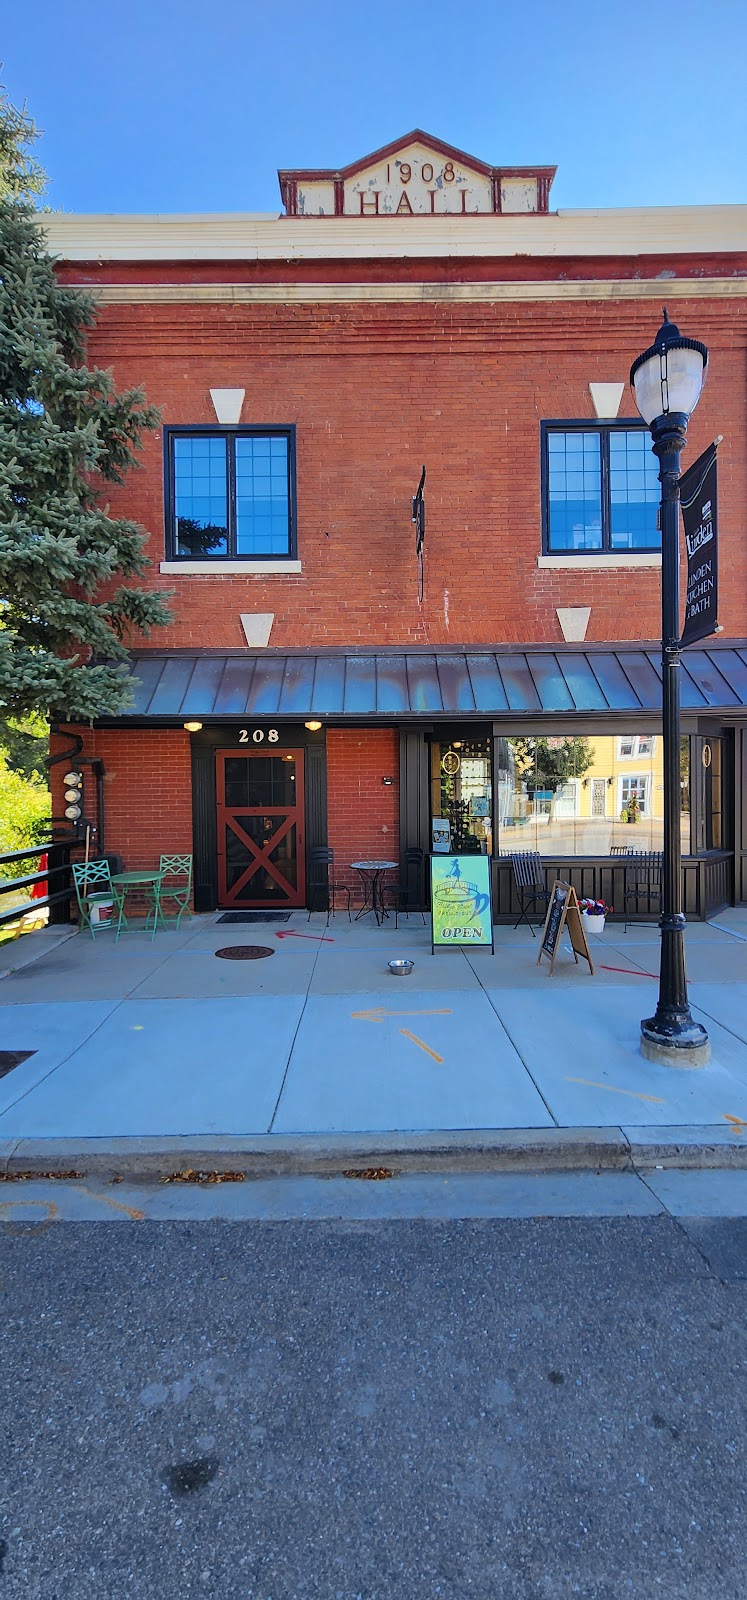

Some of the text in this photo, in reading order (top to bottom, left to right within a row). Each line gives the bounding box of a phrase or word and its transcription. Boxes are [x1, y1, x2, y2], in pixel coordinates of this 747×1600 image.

[386, 162, 456, 184] 1908
[357, 189, 479, 215] HALL
[686, 521, 713, 557] Linden
[688, 560, 711, 588] LINDEN
[686, 575, 714, 604] KITCHEN
[690, 596, 711, 616] BATH
[238, 729, 280, 743] 208
[442, 927, 483, 938] OPEN
